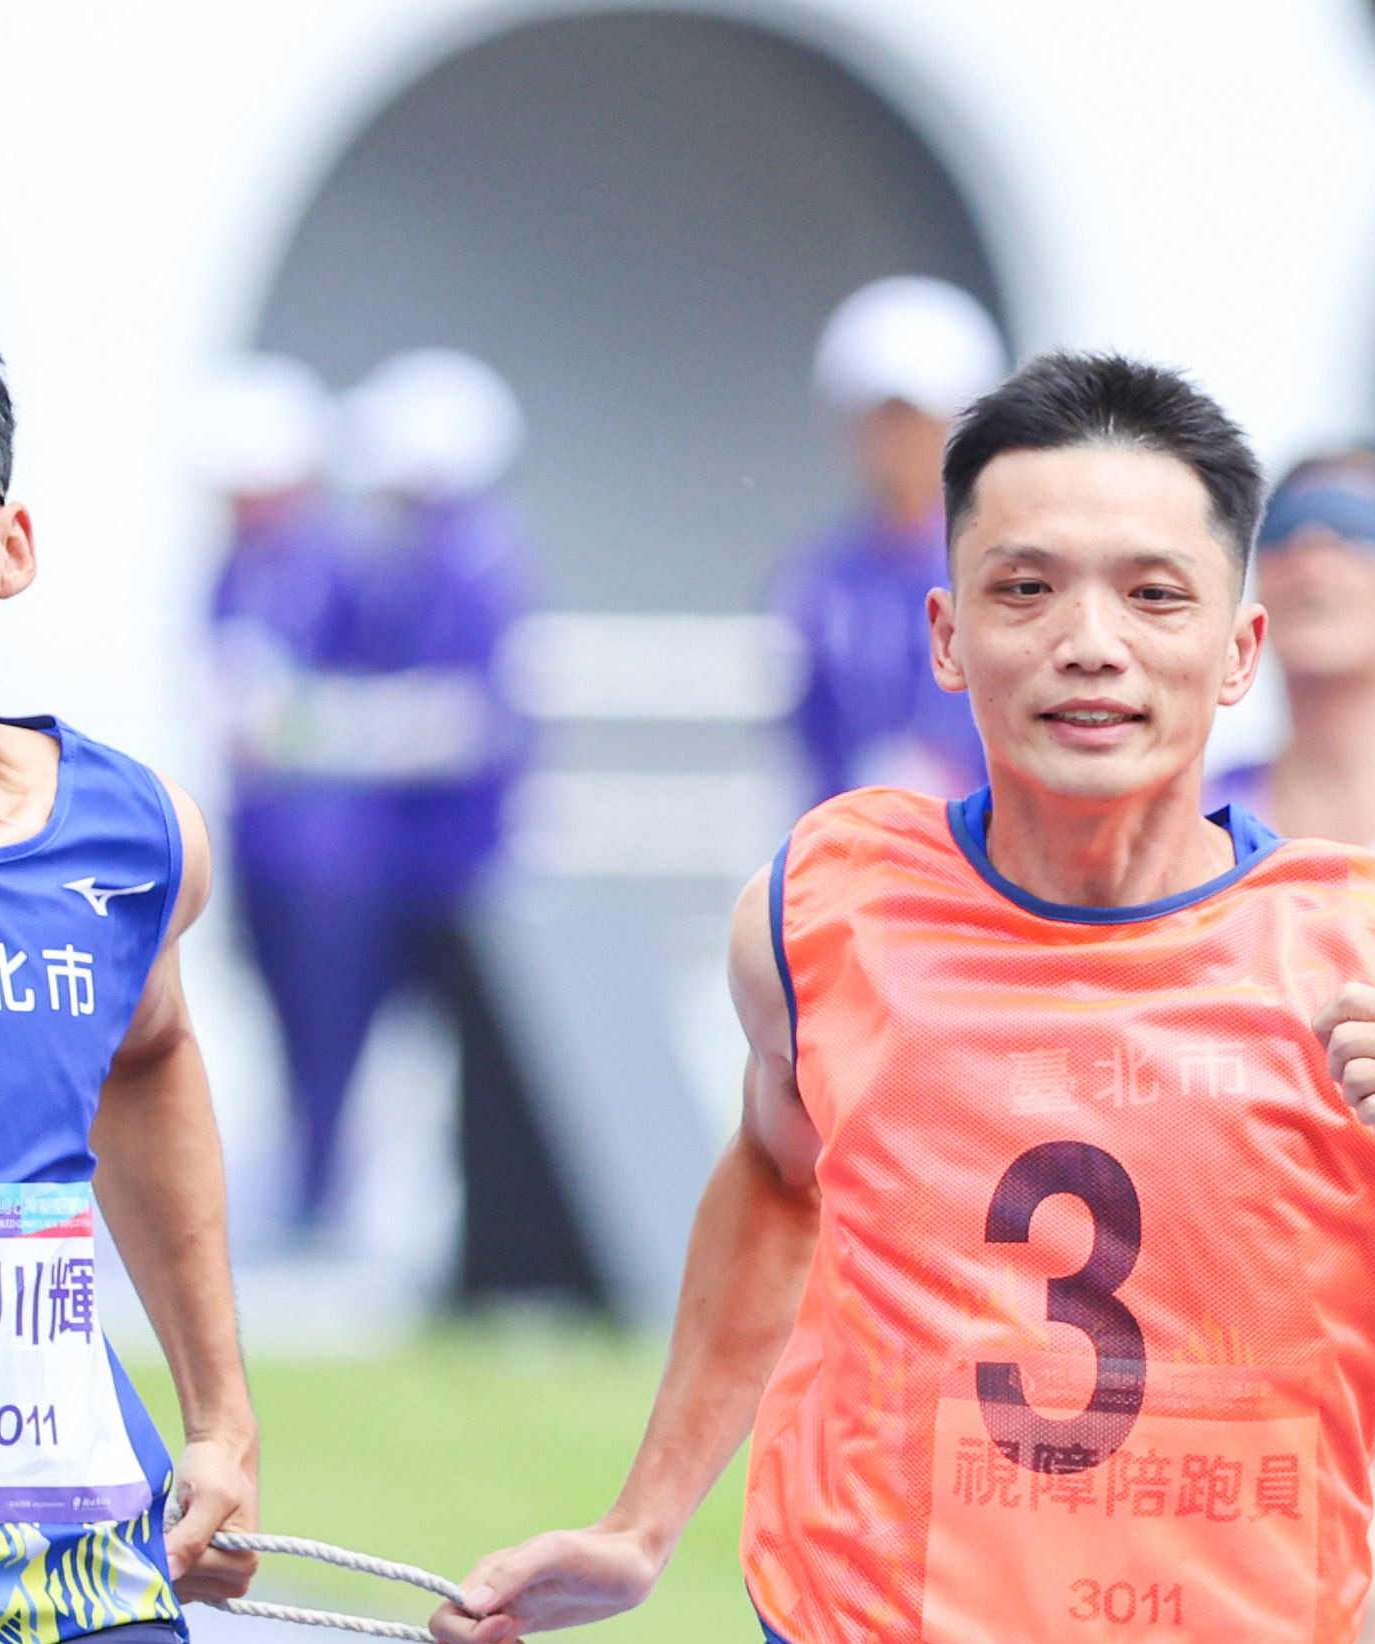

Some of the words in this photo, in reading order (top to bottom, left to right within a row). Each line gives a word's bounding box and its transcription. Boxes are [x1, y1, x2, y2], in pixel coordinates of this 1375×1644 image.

[1009, 1036, 1247, 1116] 臺北市
[976, 1140, 1147, 1475] 3
[951, 1436, 1303, 1524] 視障陪跑員
[1067, 1577, 1185, 1627] 3011
